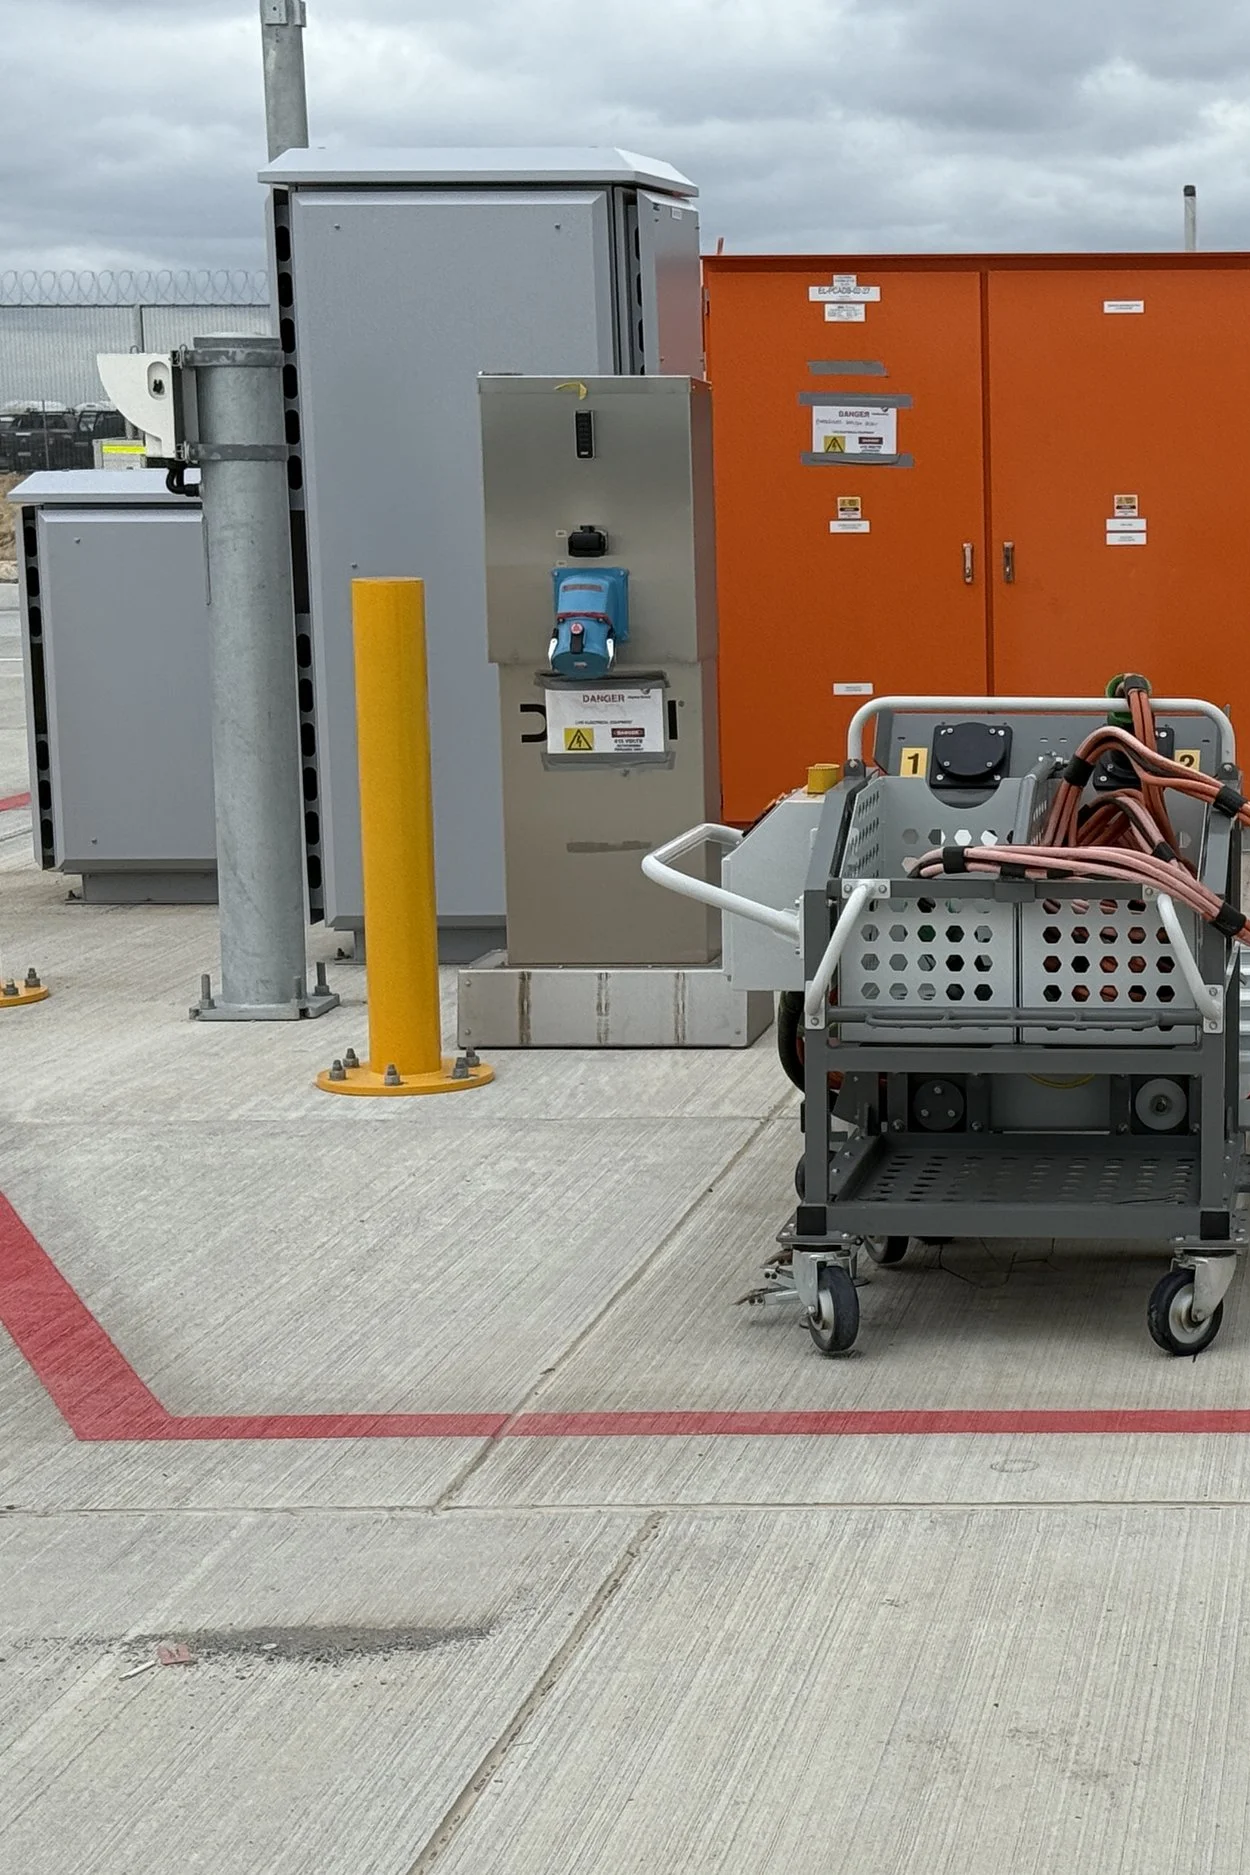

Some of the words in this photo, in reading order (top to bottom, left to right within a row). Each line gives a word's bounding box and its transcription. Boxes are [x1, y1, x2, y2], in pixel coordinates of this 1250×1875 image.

[838, 410, 870, 418] DANGER
[582, 694, 625, 703] DANGER
[907, 752, 919, 775] 1
